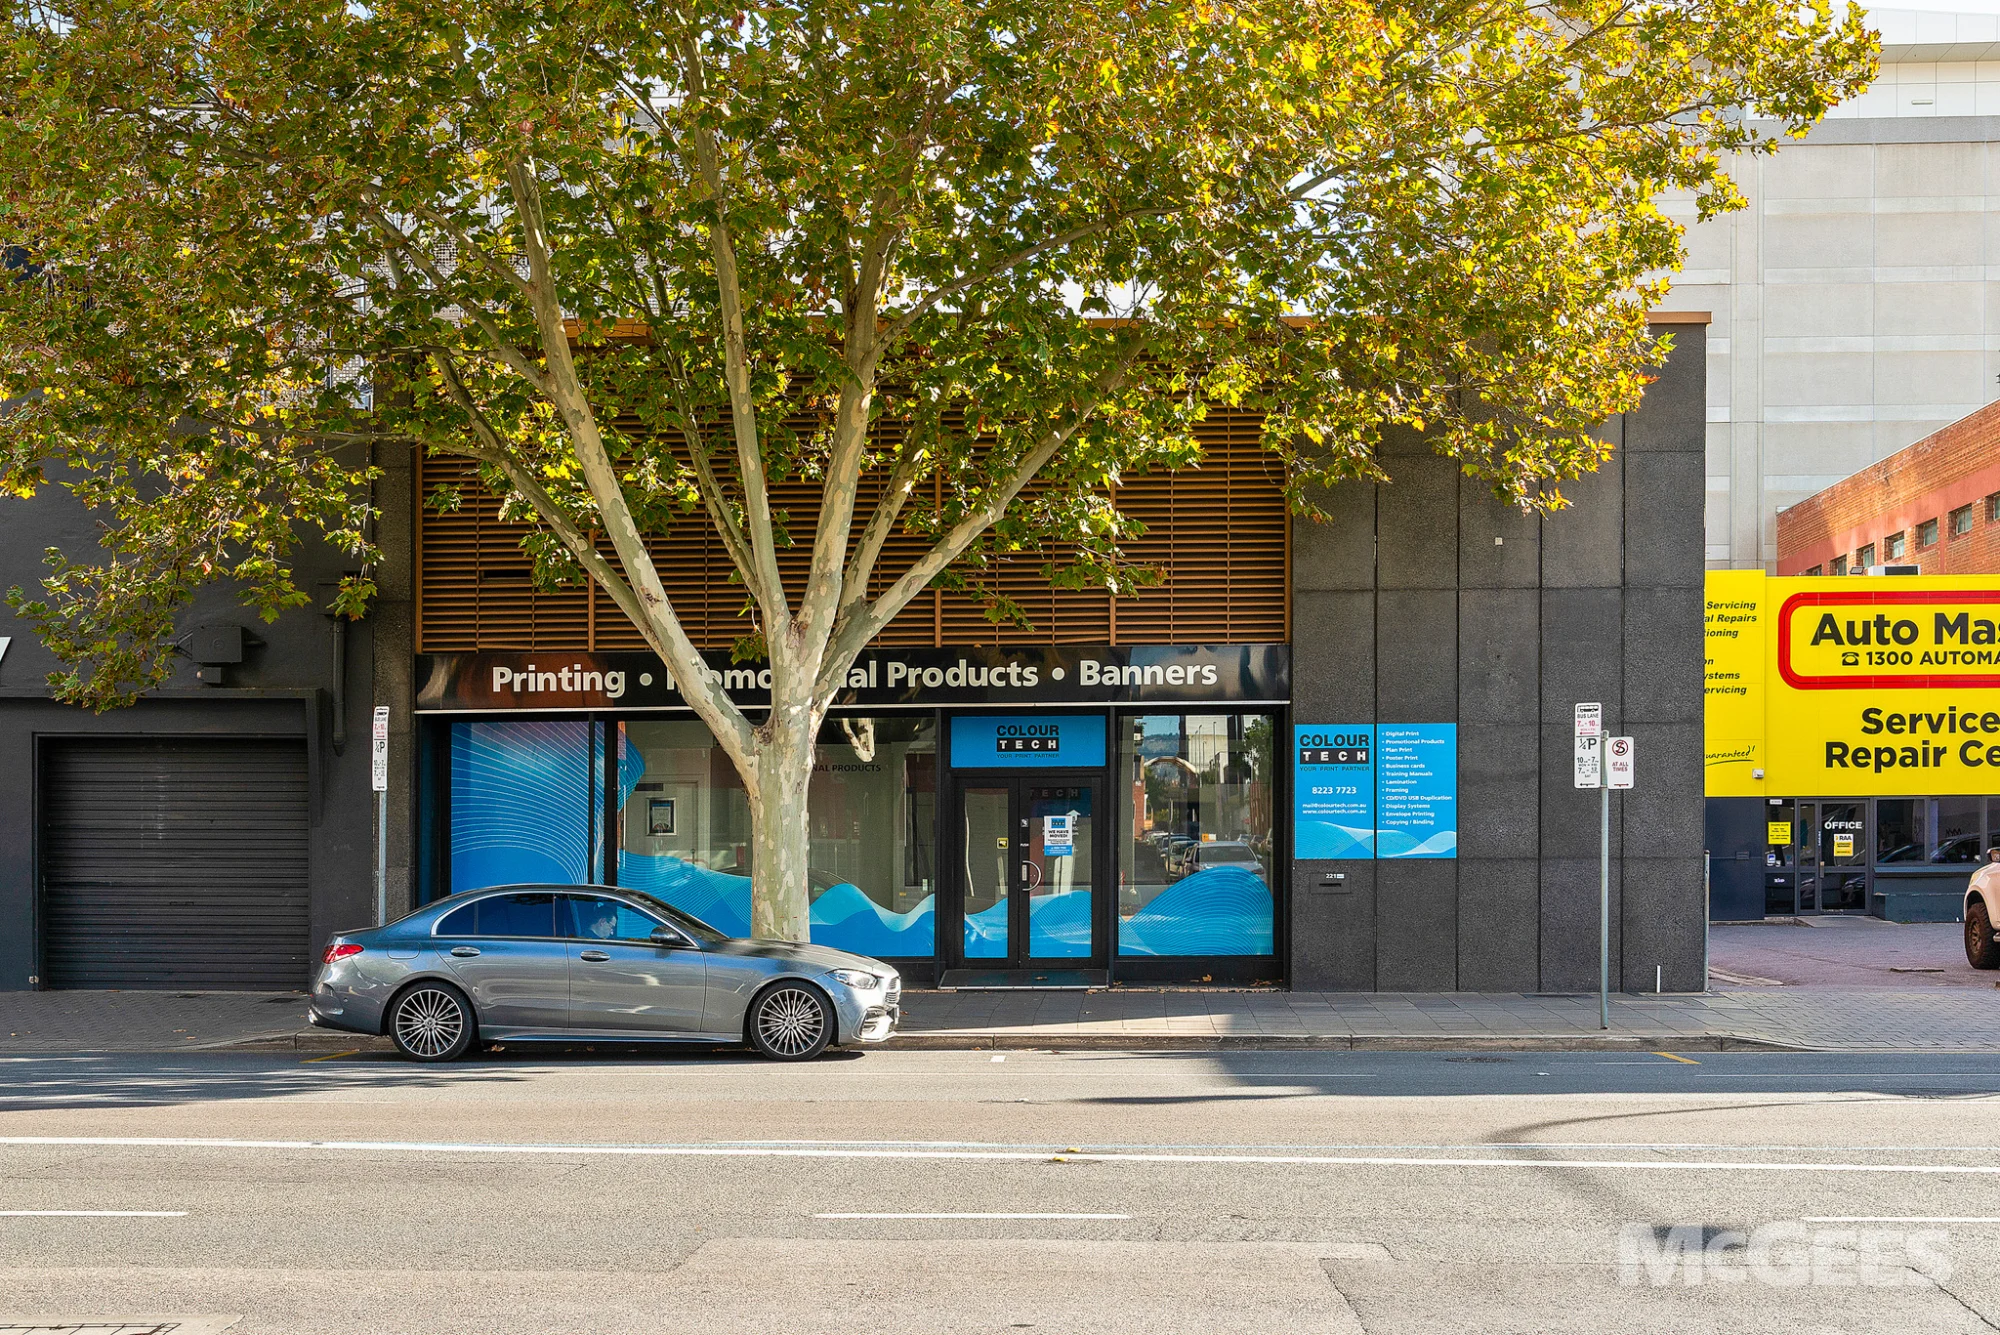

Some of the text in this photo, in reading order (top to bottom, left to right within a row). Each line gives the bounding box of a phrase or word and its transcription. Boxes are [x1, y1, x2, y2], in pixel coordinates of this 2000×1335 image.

[1706, 601, 1756, 611] Servicing
[1717, 614, 1757, 624] Repairs
[1704, 629, 1739, 638] ioning
[1810, 612, 2000, 646] Auto Ma
[1866, 651, 1913, 666] 1300
[492, 664, 625, 698] Printing
[887, 659, 1039, 689] Products
[1080, 660, 1218, 687] Banners
[1861, 706, 2000, 735] Service
[996, 725, 1059, 736] COLOUR
[1000, 740, 1057, 749] TECH
[1300, 734, 1370, 747] COLOUR
[1303, 751, 1366, 761] TECH
[1825, 740, 1947, 774] Repair
[832, 764, 881, 772] PRODUCTS
[1824, 821, 1863, 829] OFFICE
